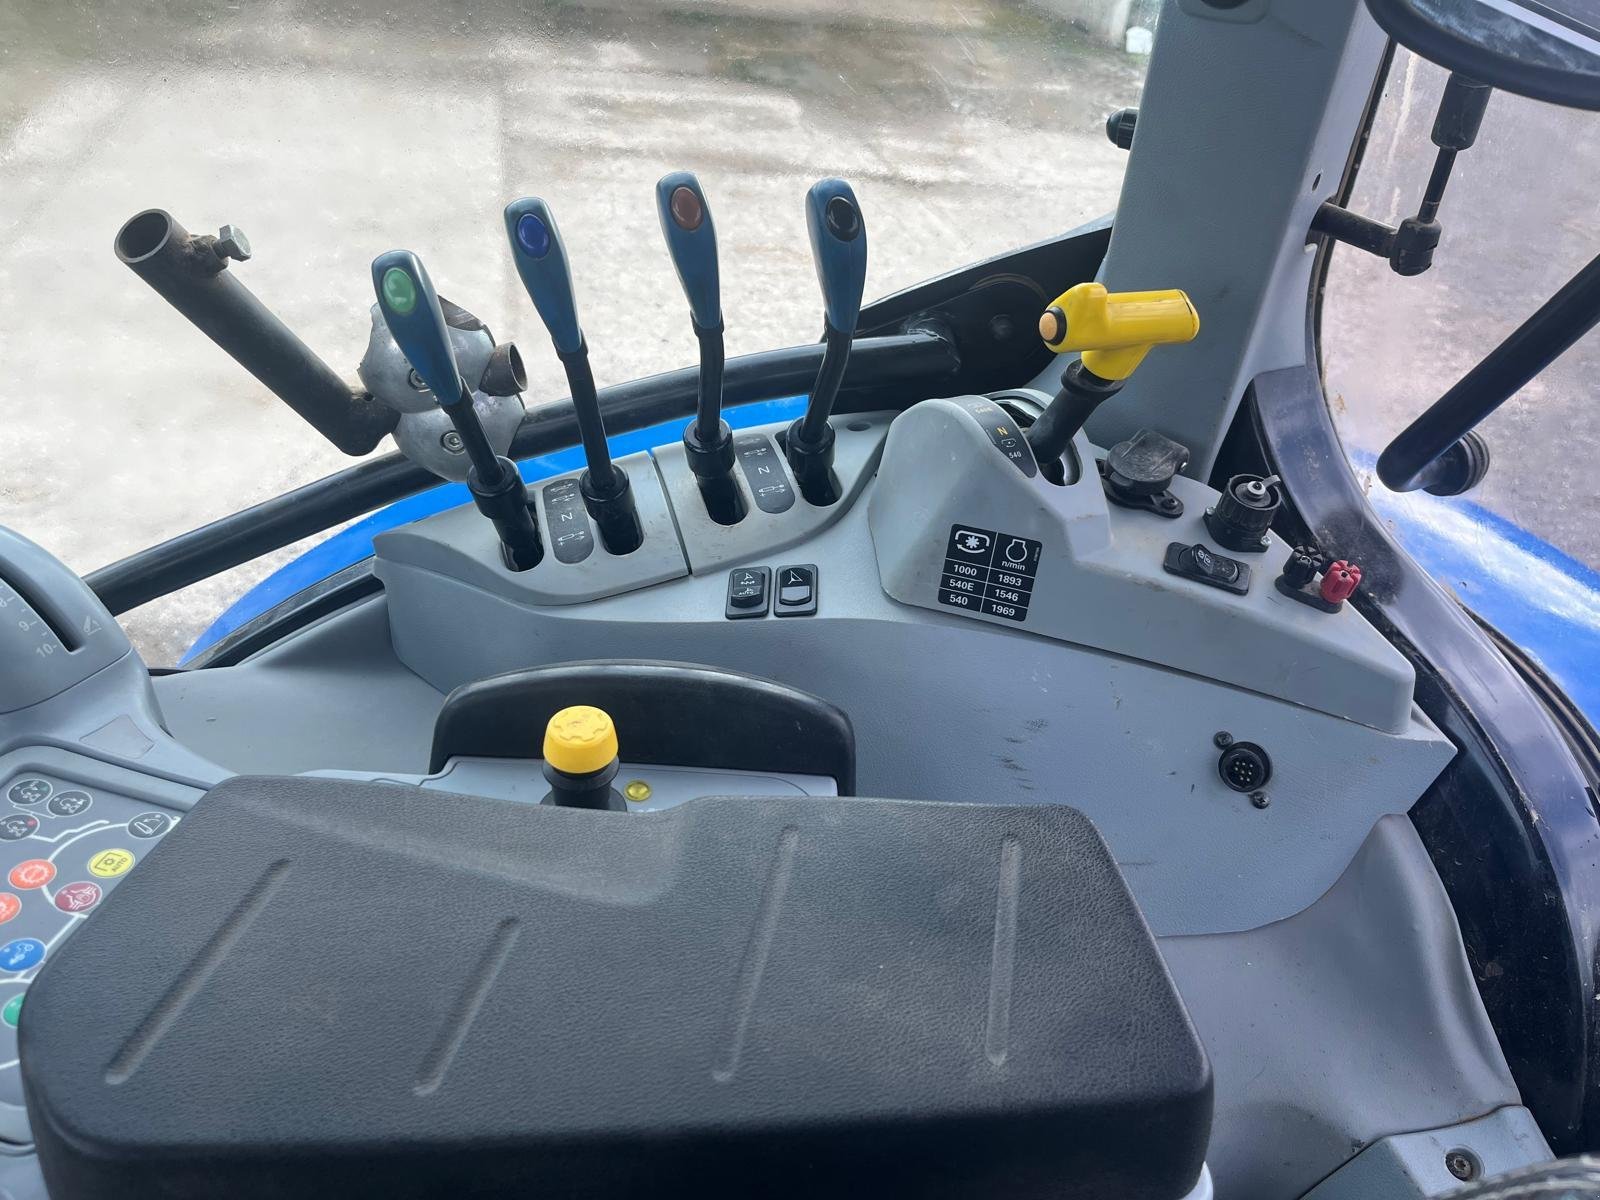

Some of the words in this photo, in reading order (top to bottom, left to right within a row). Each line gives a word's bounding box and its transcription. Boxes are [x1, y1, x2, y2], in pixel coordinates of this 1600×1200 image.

[996, 426, 1009, 436] N
[1009, 450, 1022, 459] 540
[954, 564, 977, 576] 1000
[1001, 560, 1026, 571] n/min
[949, 579, 975, 591] 540E
[998, 574, 1022, 586] 1893
[949, 594, 968, 606] 540
[995, 589, 1019, 602] 1546
[991, 604, 1015, 616] 1969
[18, 620, 30, 631] 9
[35, 643, 54, 658] 10
